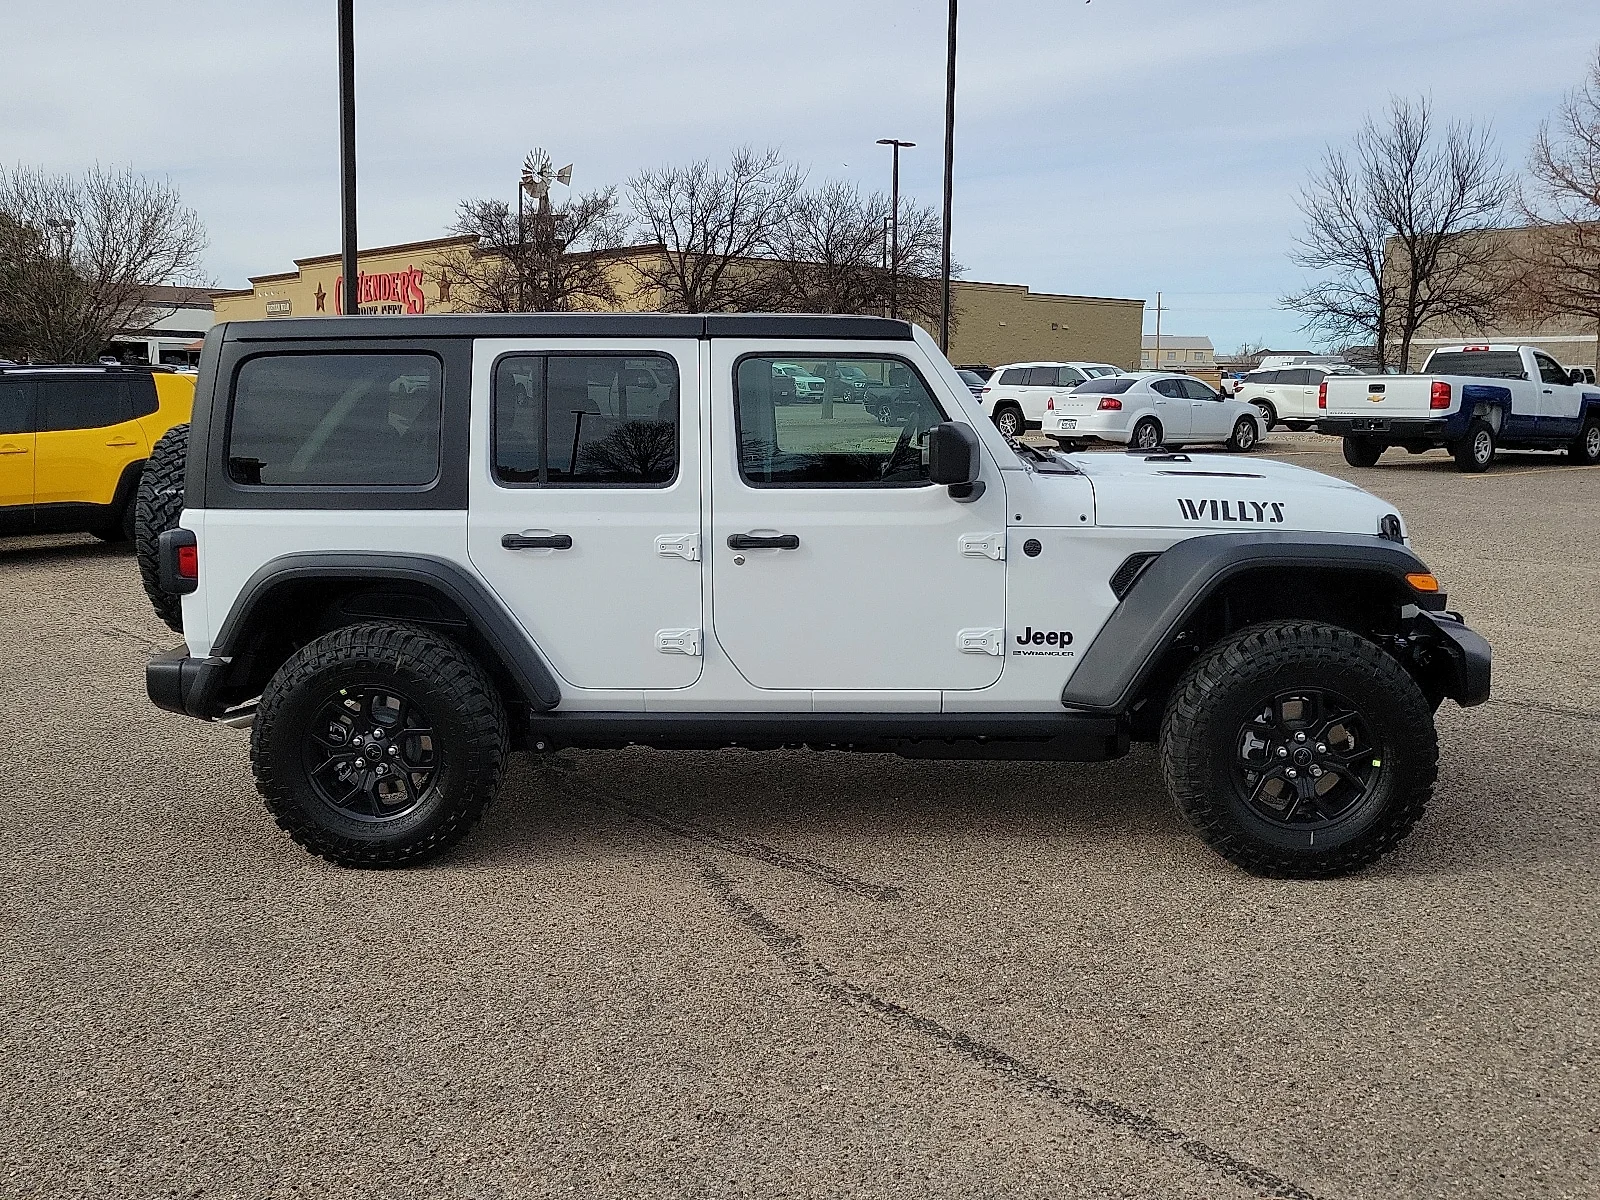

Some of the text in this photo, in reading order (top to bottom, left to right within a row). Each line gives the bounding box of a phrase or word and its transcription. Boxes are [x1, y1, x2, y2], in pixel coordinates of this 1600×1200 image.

[334, 265, 425, 315] CVENDER'S
[1177, 498, 1285, 523] WILLYS
[1016, 626, 1074, 649] Jeep
